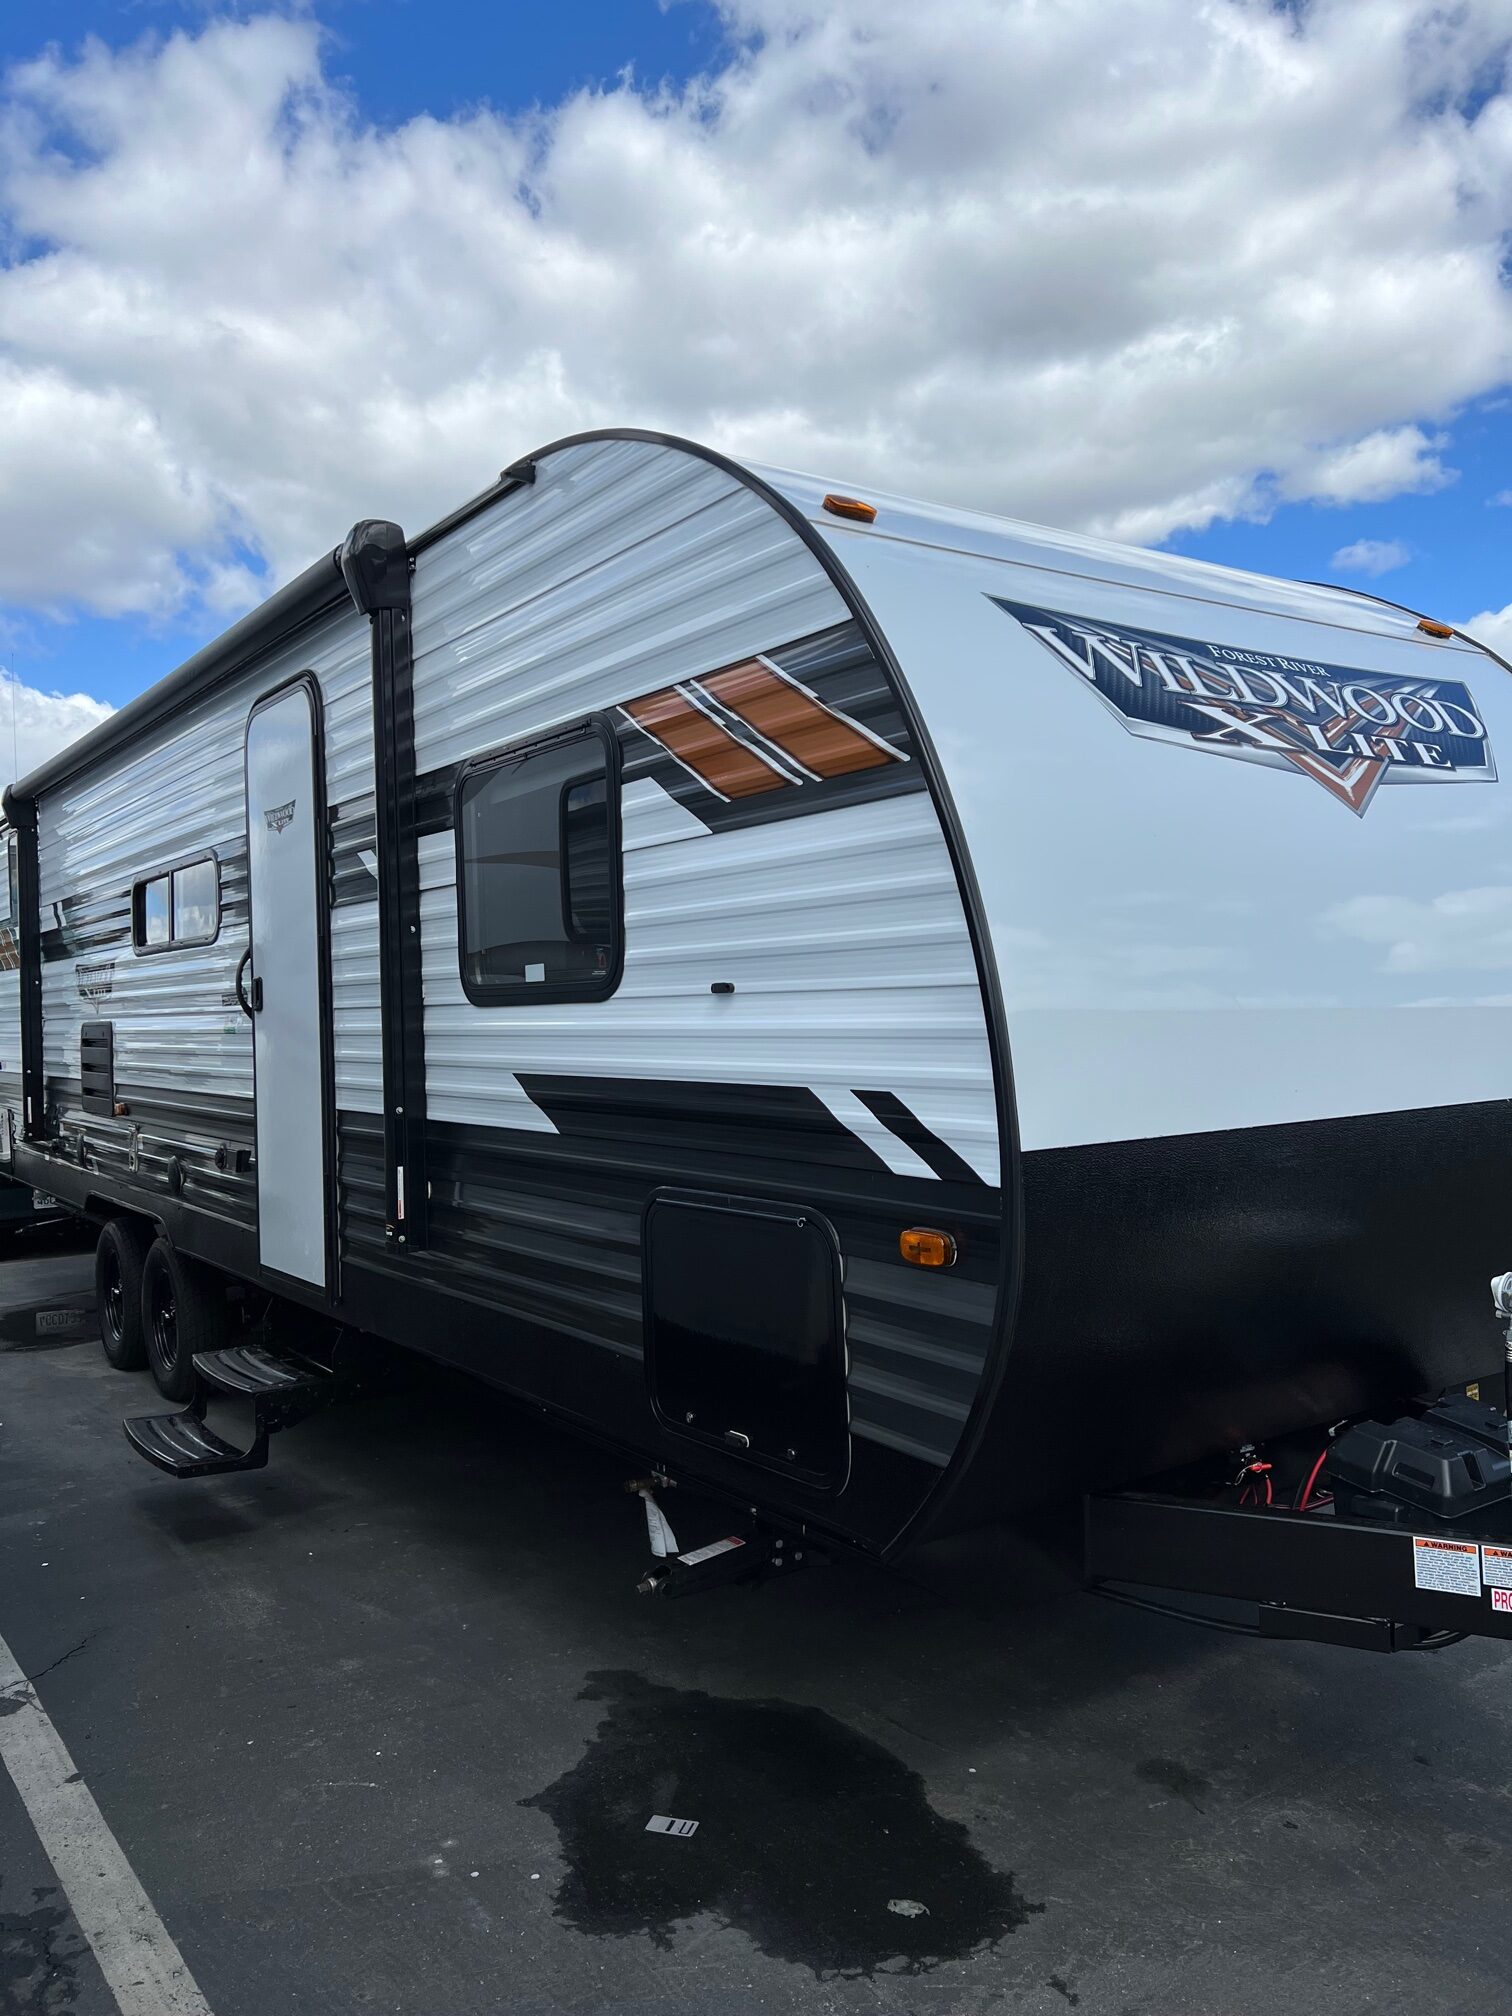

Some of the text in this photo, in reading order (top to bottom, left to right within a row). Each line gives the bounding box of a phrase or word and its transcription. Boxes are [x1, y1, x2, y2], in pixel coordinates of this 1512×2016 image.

[1020, 621, 1486, 739] WILDWOOD
[1206, 644, 1331, 677] FOREST RIVER
[1303, 722, 1454, 769] LITE
[1431, 1541, 1467, 1552] WARNING
